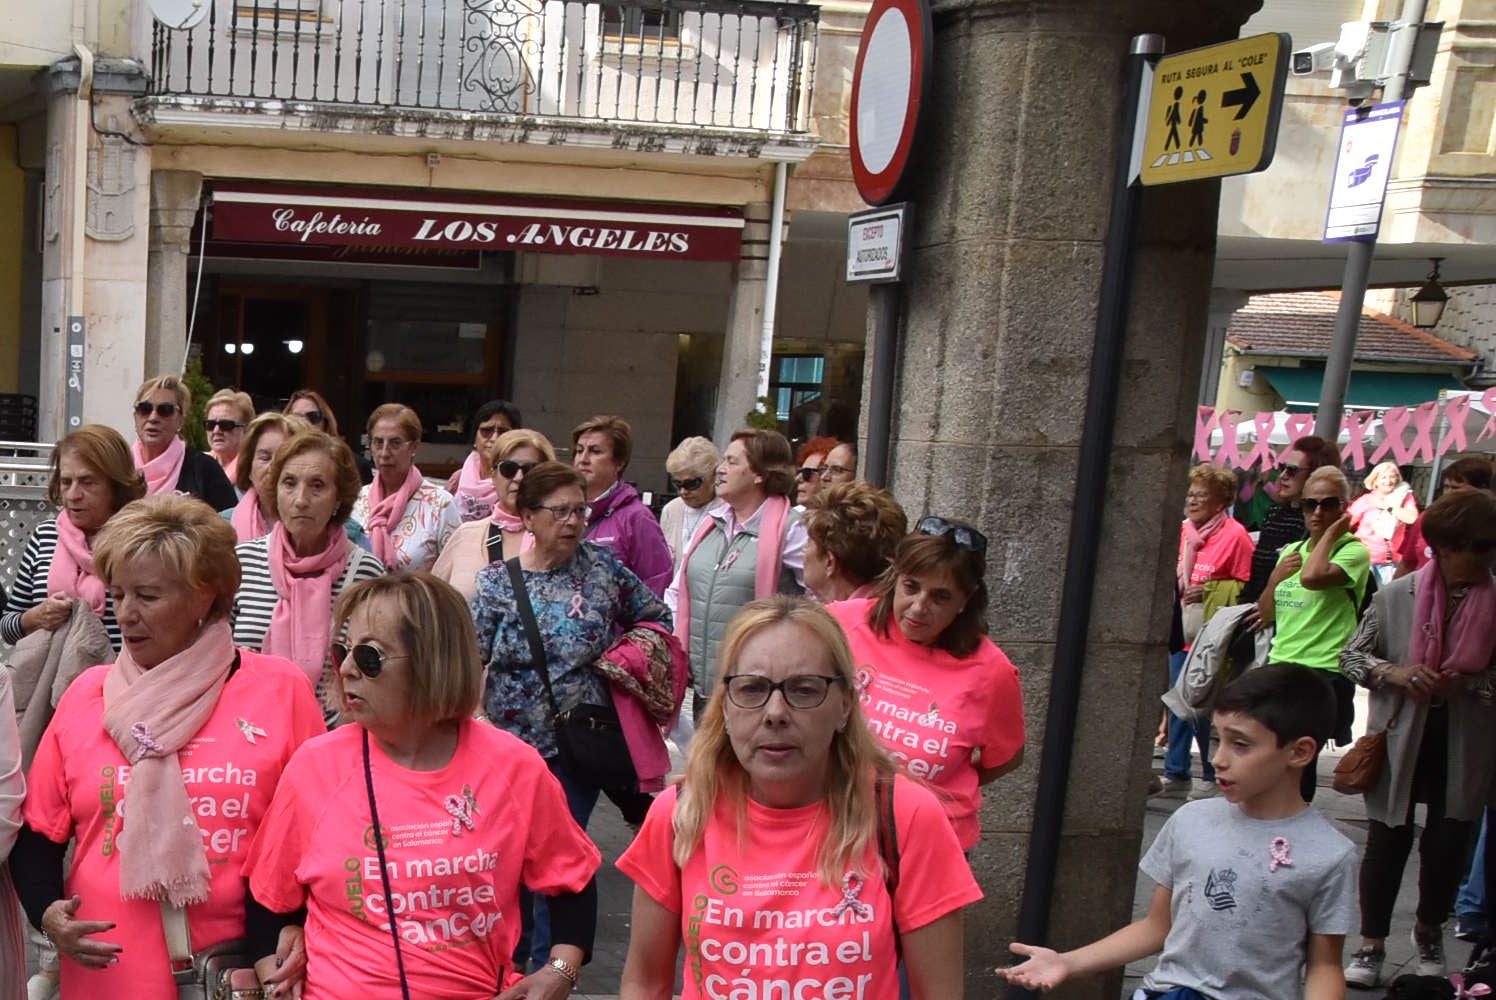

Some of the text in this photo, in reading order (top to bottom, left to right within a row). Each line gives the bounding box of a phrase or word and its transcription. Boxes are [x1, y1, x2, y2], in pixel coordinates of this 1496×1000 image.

[1161, 71, 1182, 84] RUTA
[1185, 63, 1219, 79] SEGURA
[1223, 61, 1233, 71] AL
[272, 208, 382, 242] Cafetería
[411, 218, 499, 243] LOS
[506, 222, 690, 253] ANGELES
[863, 225, 884, 240] EXCEPTO
[857, 246, 888, 263] AUTORIZADOS
[922, 737, 949, 758] el
[100, 765, 115, 856] GUIJUELO
[222, 793, 249, 818] el
[390, 822, 429, 832] asociación
[391, 832, 414, 840] contra
[402, 838, 444, 847] Salamanca
[363, 848, 499, 880] En marcha
[744, 872, 787, 881] asociación
[365, 884, 474, 914] contra
[754, 889, 800, 897] Salamanca
[705, 898, 743, 928] En
[700, 931, 873, 966] contra el
